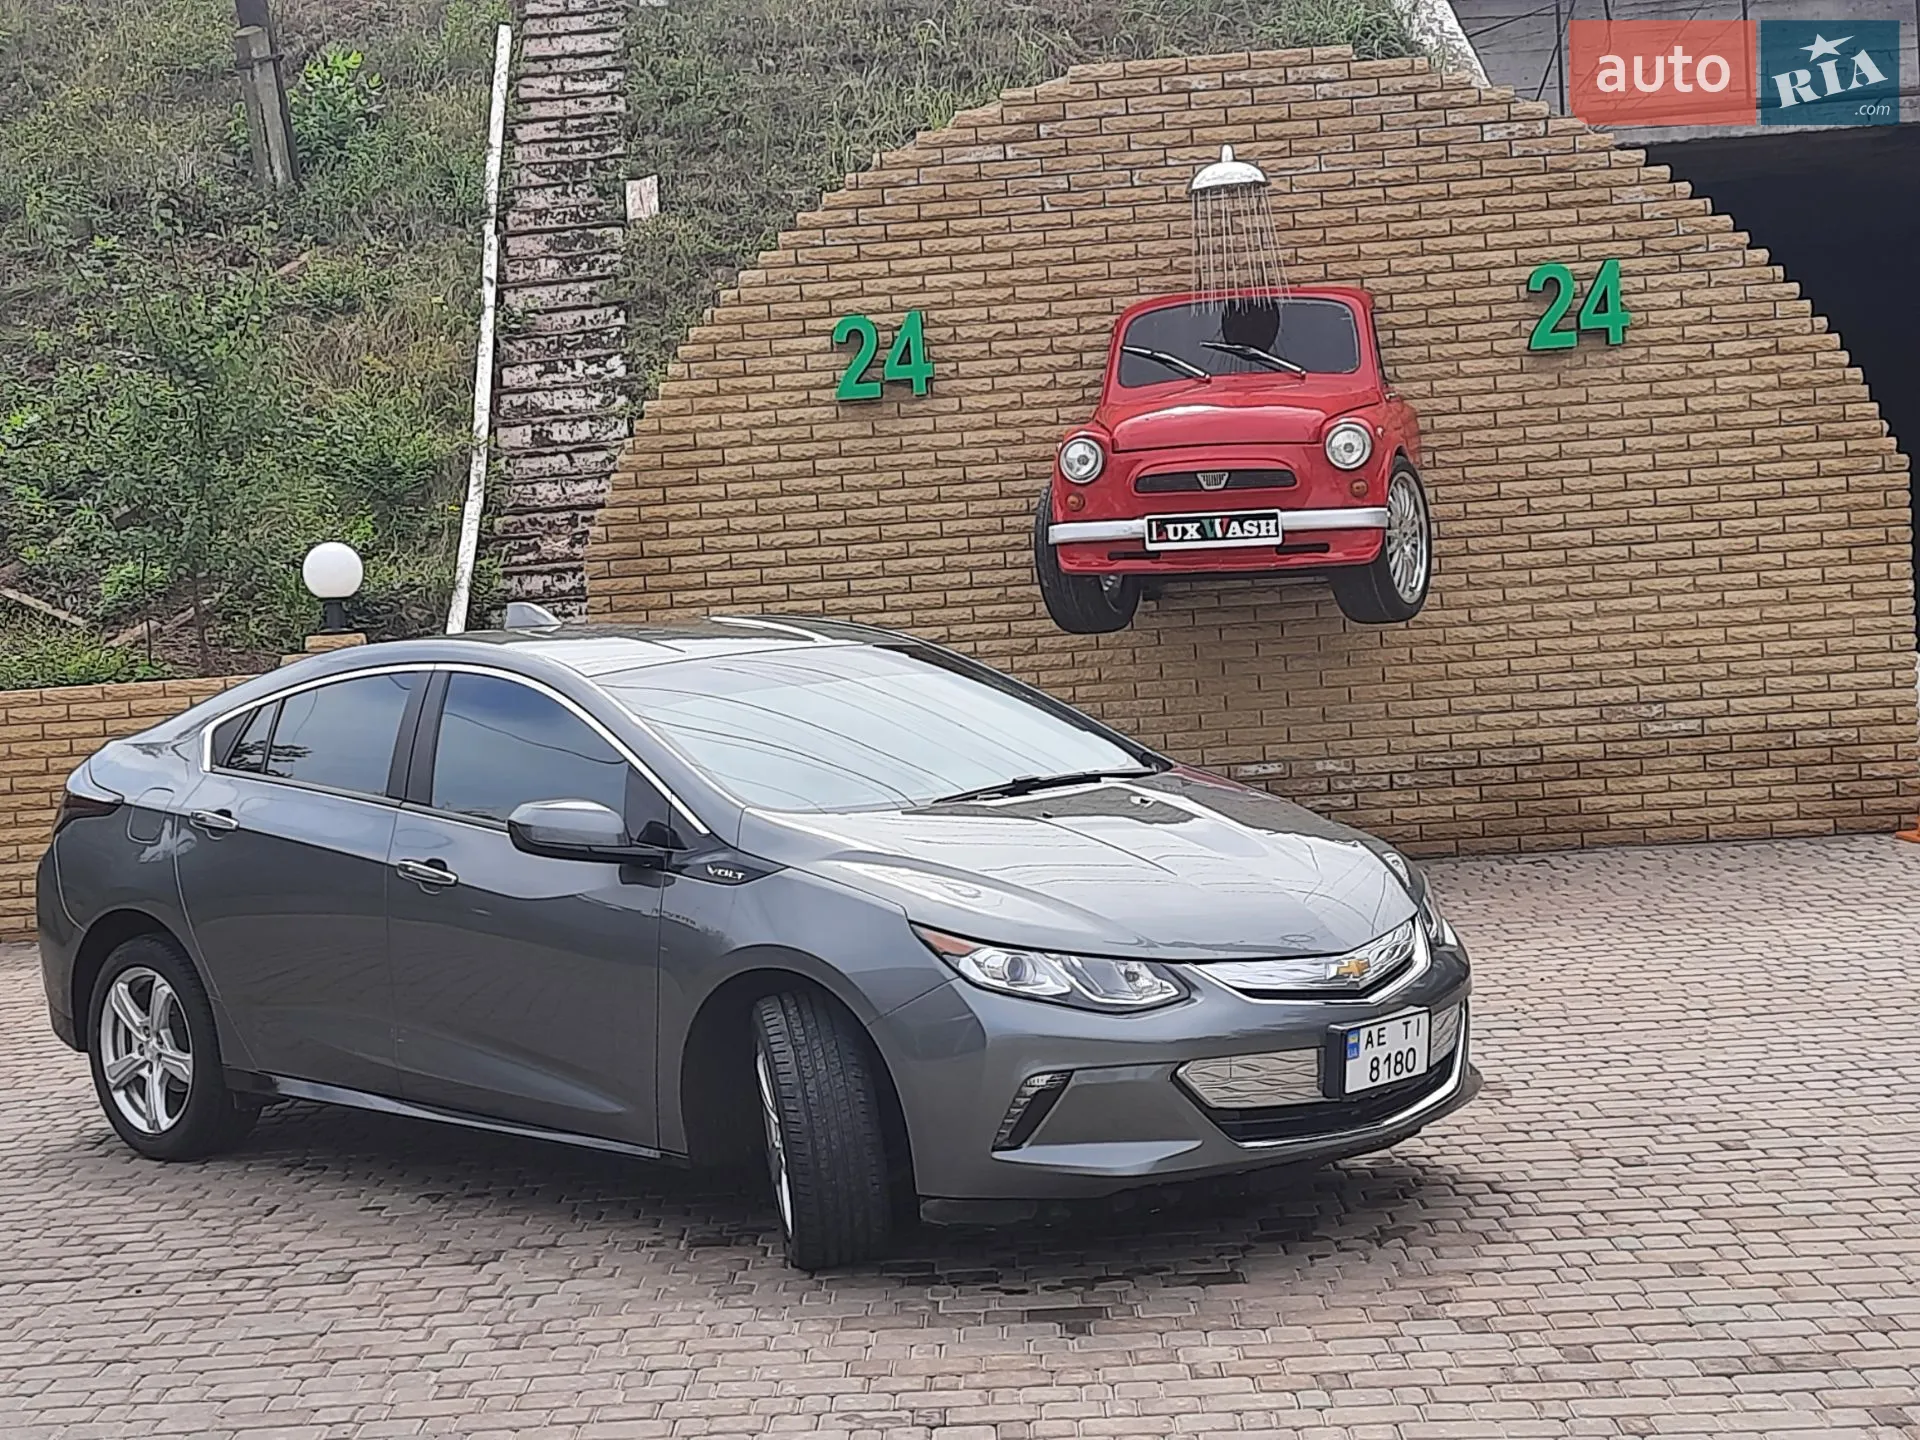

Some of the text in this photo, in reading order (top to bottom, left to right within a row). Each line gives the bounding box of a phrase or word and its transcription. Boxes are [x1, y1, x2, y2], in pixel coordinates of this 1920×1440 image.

[1527, 258, 1632, 351] 24
[832, 309, 935, 401] 24
[706, 864, 746, 880] VOLT
[1365, 1027, 1387, 1050] AE
[1369, 1047, 1417, 1083] 8180
